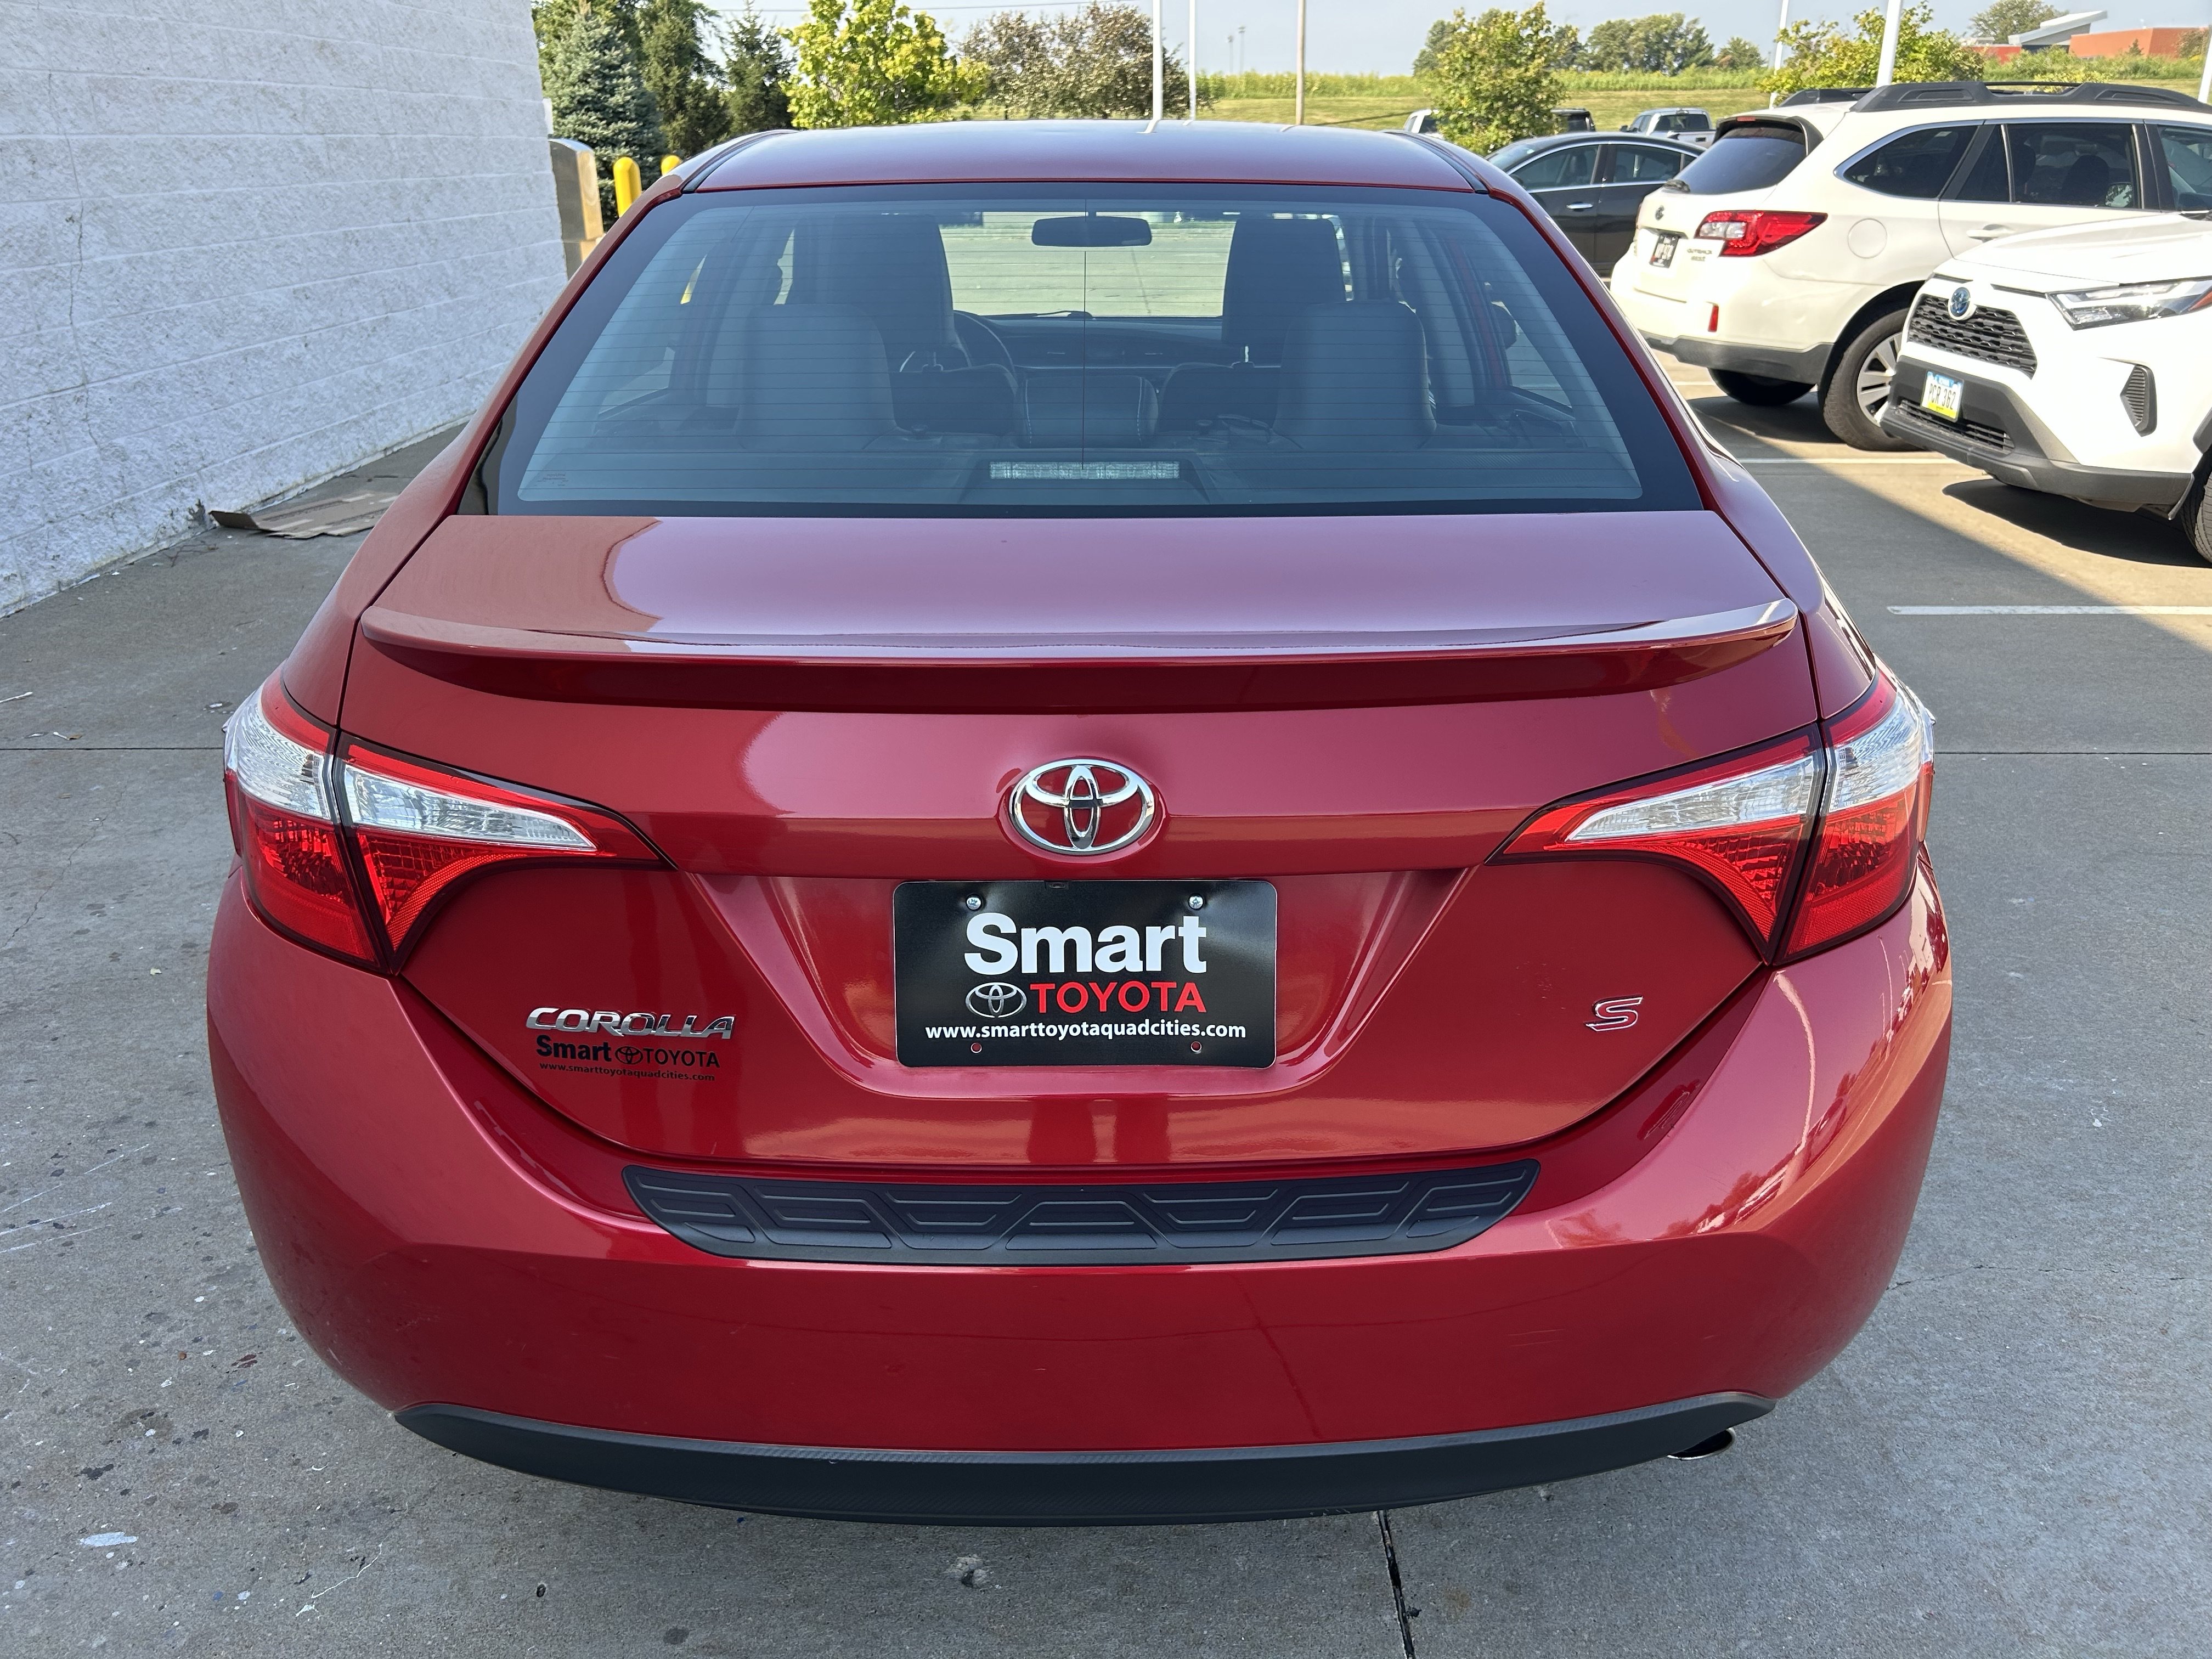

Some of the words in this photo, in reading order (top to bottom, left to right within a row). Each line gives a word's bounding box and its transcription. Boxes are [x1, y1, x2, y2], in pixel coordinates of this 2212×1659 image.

[1928, 383, 1941, 404] PCR
[1942, 388, 1956, 410] 362
[964, 912, 1207, 975] Smart
[1030, 981, 1207, 1013] TOYOTA
[1585, 995, 1644, 1032] S
[525, 1006, 736, 1040] COROLLA
[926, 1019, 1246, 1040] www.smarttoyotaquadcities.com
[535, 1034, 612, 1063] Smart
[641, 1048, 720, 1068] TOYOTA
[539, 1061, 715, 1081] www.smarttoyotaquadcities.com
